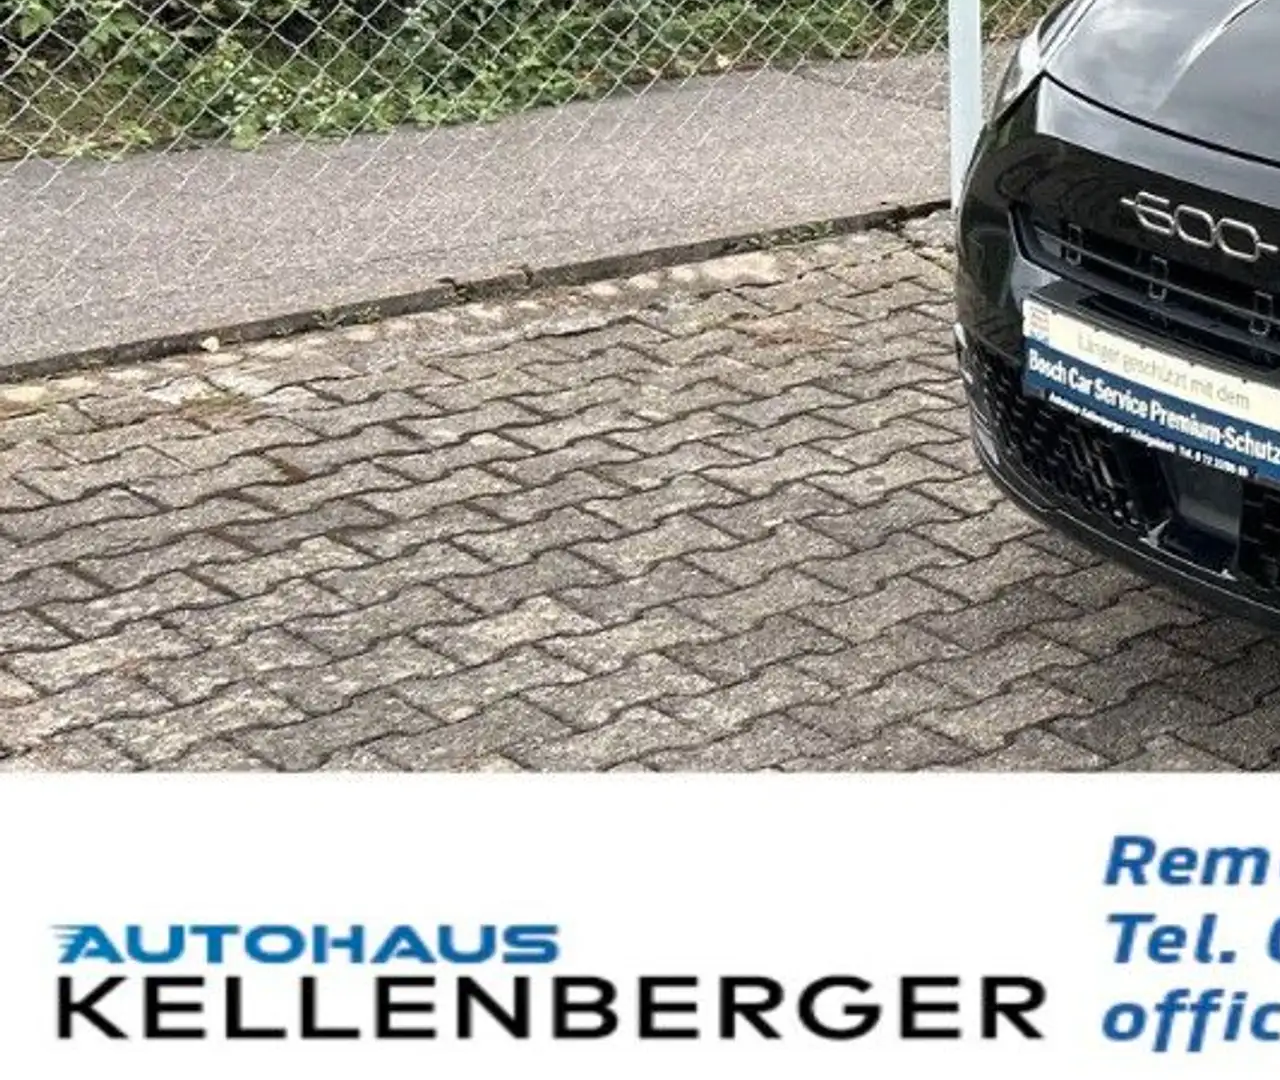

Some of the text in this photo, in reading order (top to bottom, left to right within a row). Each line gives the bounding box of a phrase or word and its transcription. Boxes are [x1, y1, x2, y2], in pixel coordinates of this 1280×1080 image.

[1133, 191, 1262, 263] 600
[1029, 348, 1067, 386] Bosch
[1068, 366, 1093, 396] Car
[1093, 377, 1148, 419] Service
[1216, 383, 1251, 412] dem
